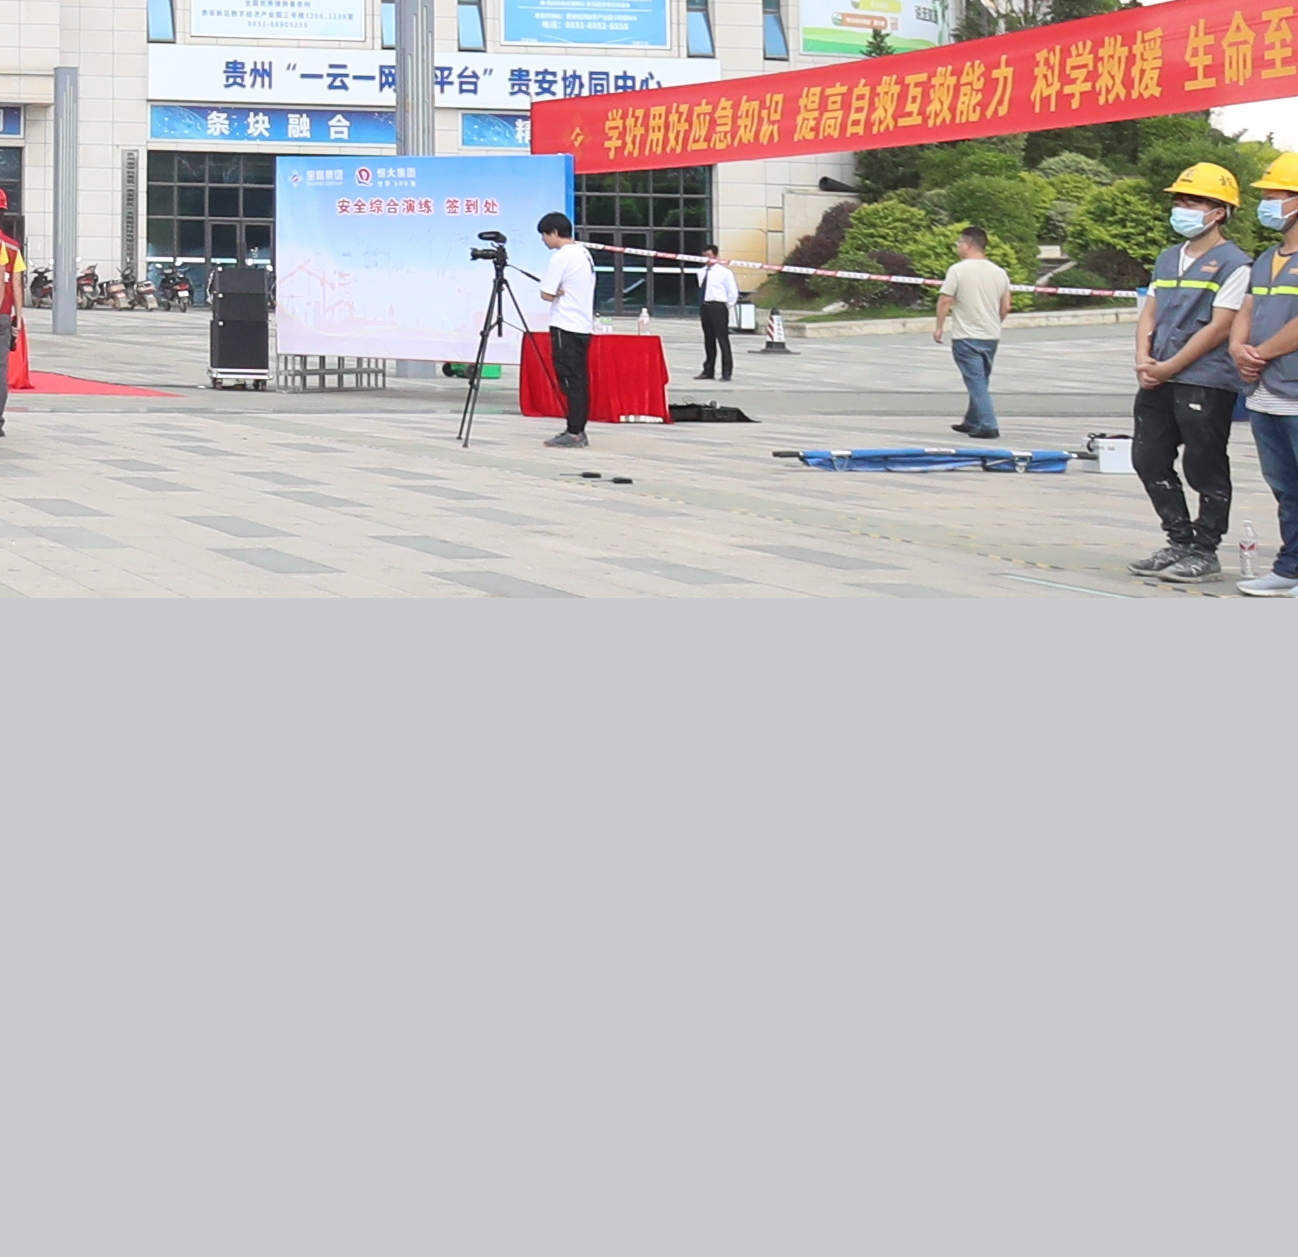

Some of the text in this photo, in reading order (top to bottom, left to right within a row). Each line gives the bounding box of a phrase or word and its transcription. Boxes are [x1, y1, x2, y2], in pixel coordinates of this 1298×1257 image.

[602, 92, 784, 161] 学好用好应急知识
[793, 54, 1015, 142] 提高自救互救能力
[1030, 27, 1165, 114] 科学救援
[206, 111, 351, 140] 条块融合
[336, 198, 500, 216] 安全综合演练 签到处
